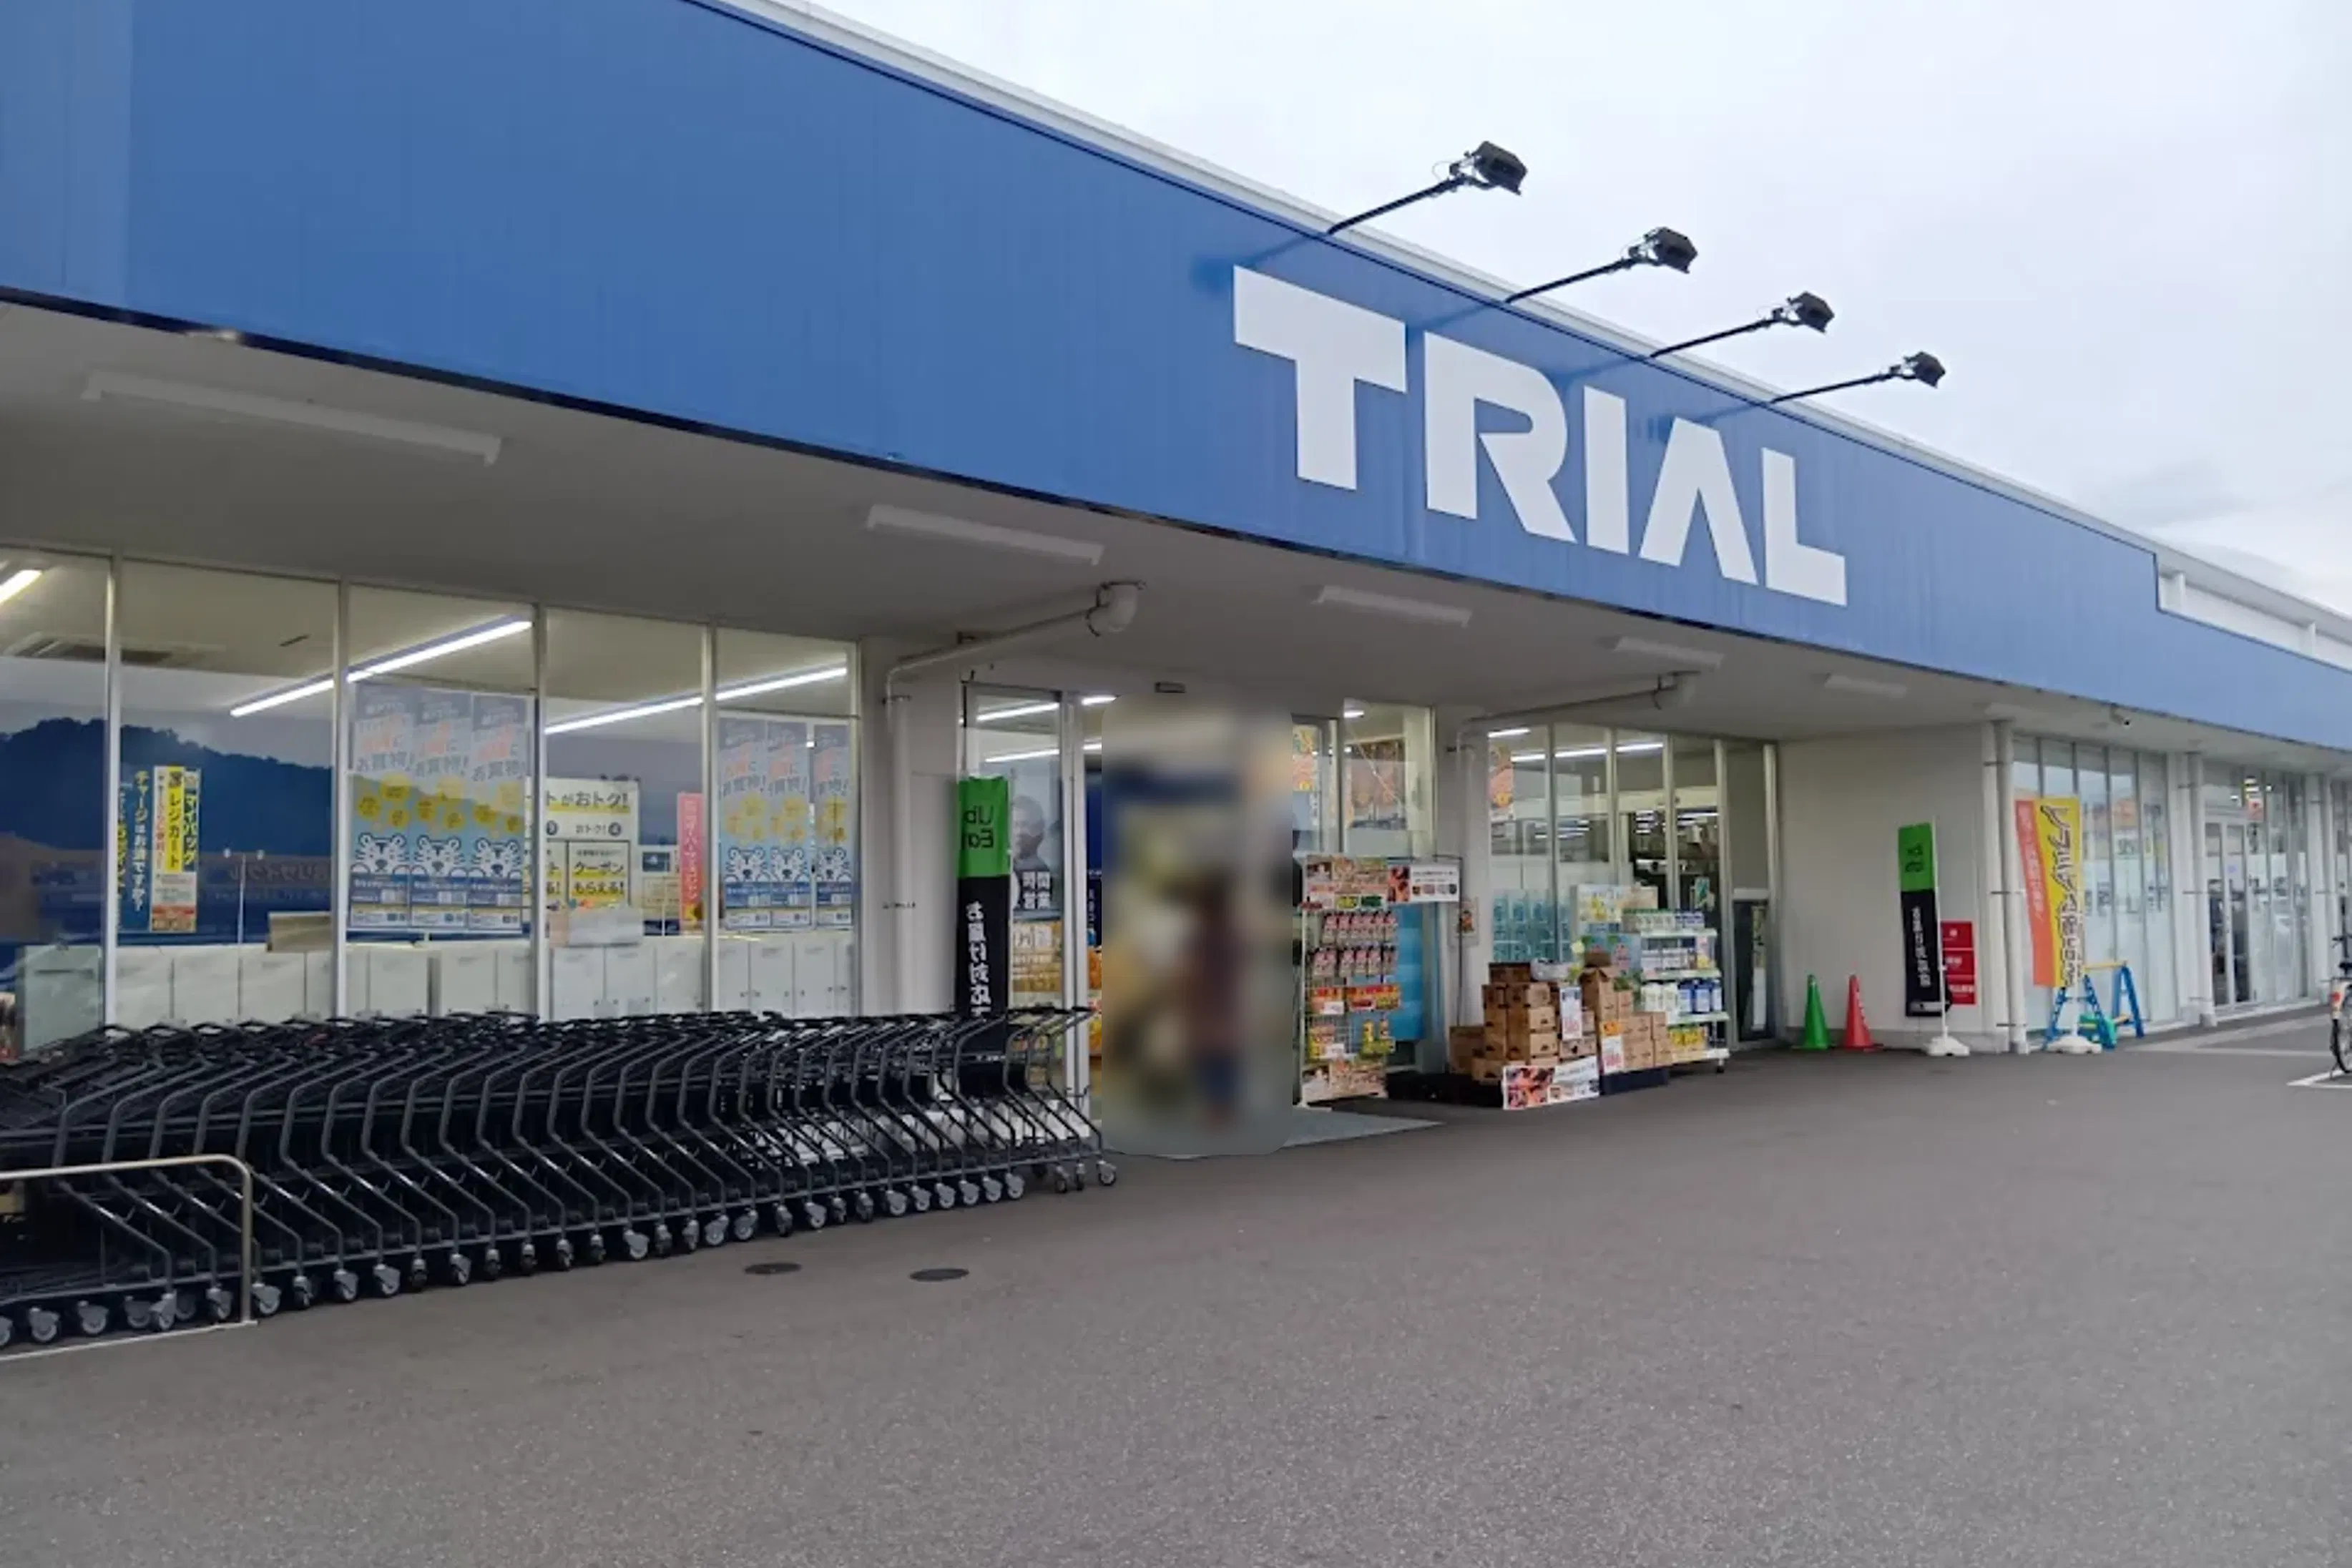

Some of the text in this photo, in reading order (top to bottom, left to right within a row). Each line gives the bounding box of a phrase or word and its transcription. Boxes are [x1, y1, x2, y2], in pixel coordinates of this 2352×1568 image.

[1234, 265, 1846, 606] TRIAL
[546, 790, 627, 808] トがおトク!
[574, 861, 624, 875] クーポン
[574, 881, 624, 894] もらえる!
